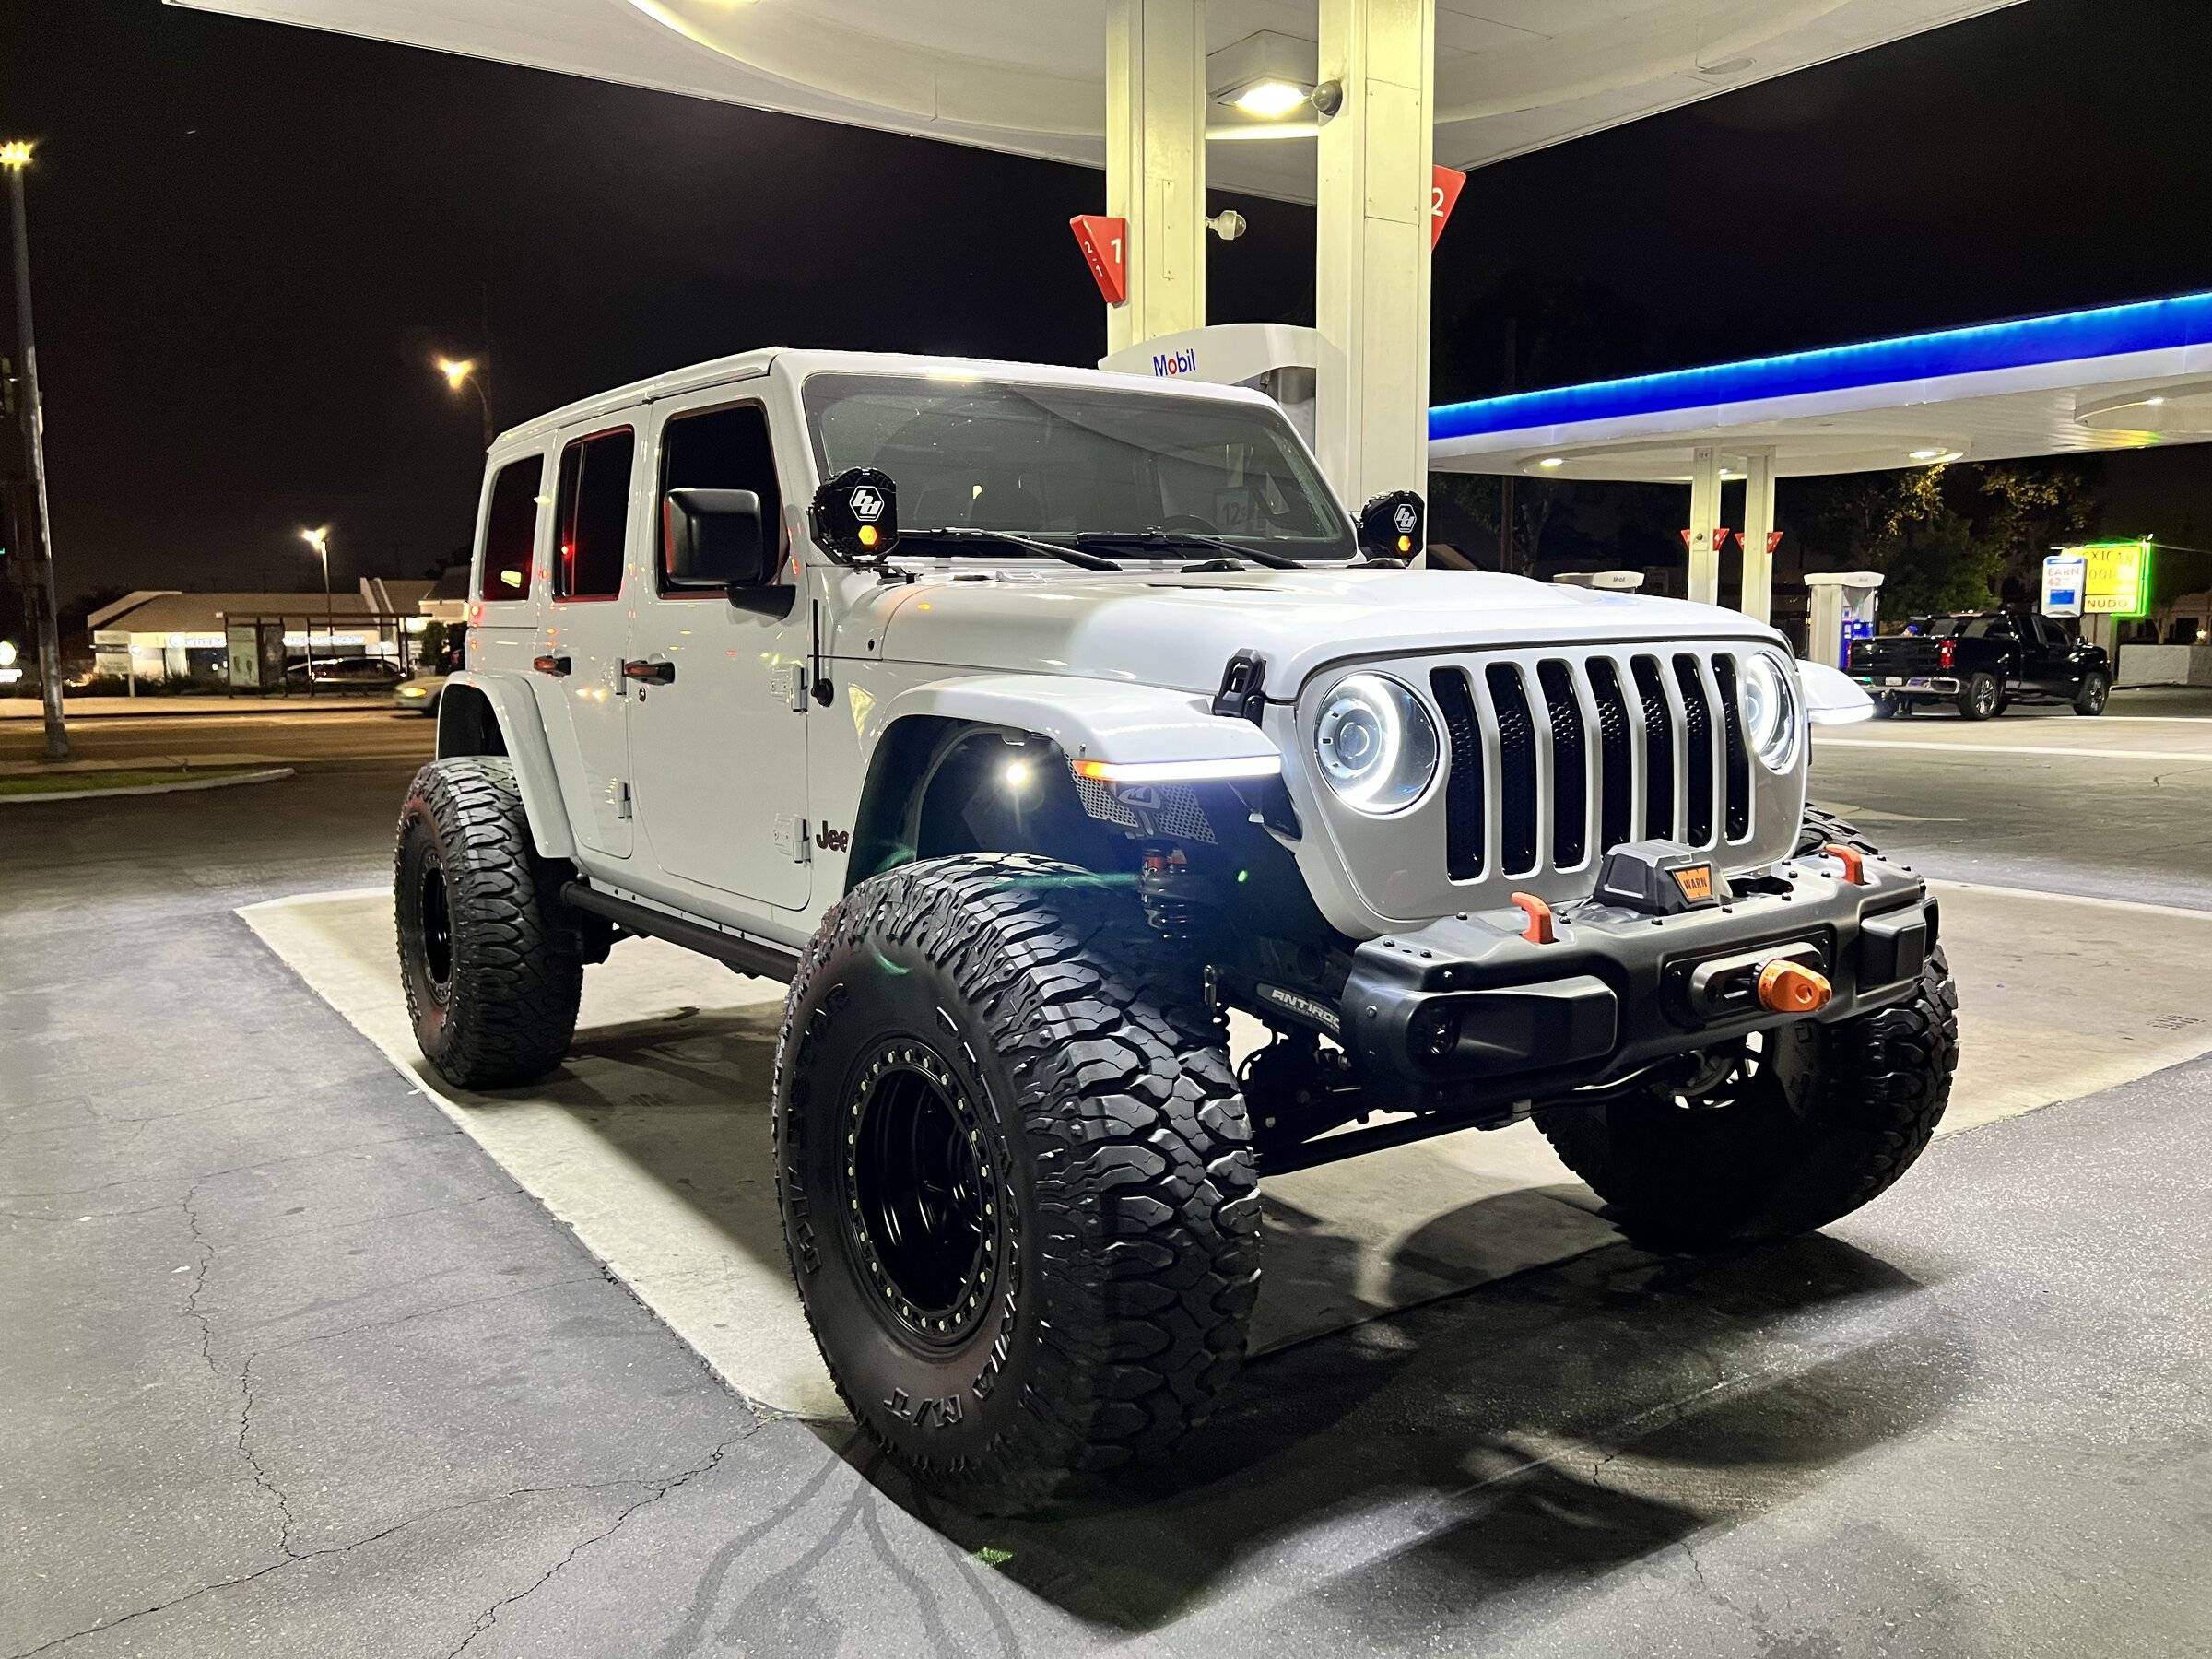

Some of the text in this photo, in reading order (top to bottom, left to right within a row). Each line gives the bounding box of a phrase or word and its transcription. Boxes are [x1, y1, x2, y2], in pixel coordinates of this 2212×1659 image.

[1431, 187, 1444, 217] 2
[1111, 239, 1122, 265] 1
[1153, 348, 1196, 377] Mobil
[2048, 567, 2079, 577] EARN
[2087, 599, 2128, 608] NUDO
[816, 820, 849, 853] Jee
[1683, 877, 1708, 891] WARN
[1272, 989, 1340, 1030] ANTIROC
[883, 1387, 964, 1428] M/T
